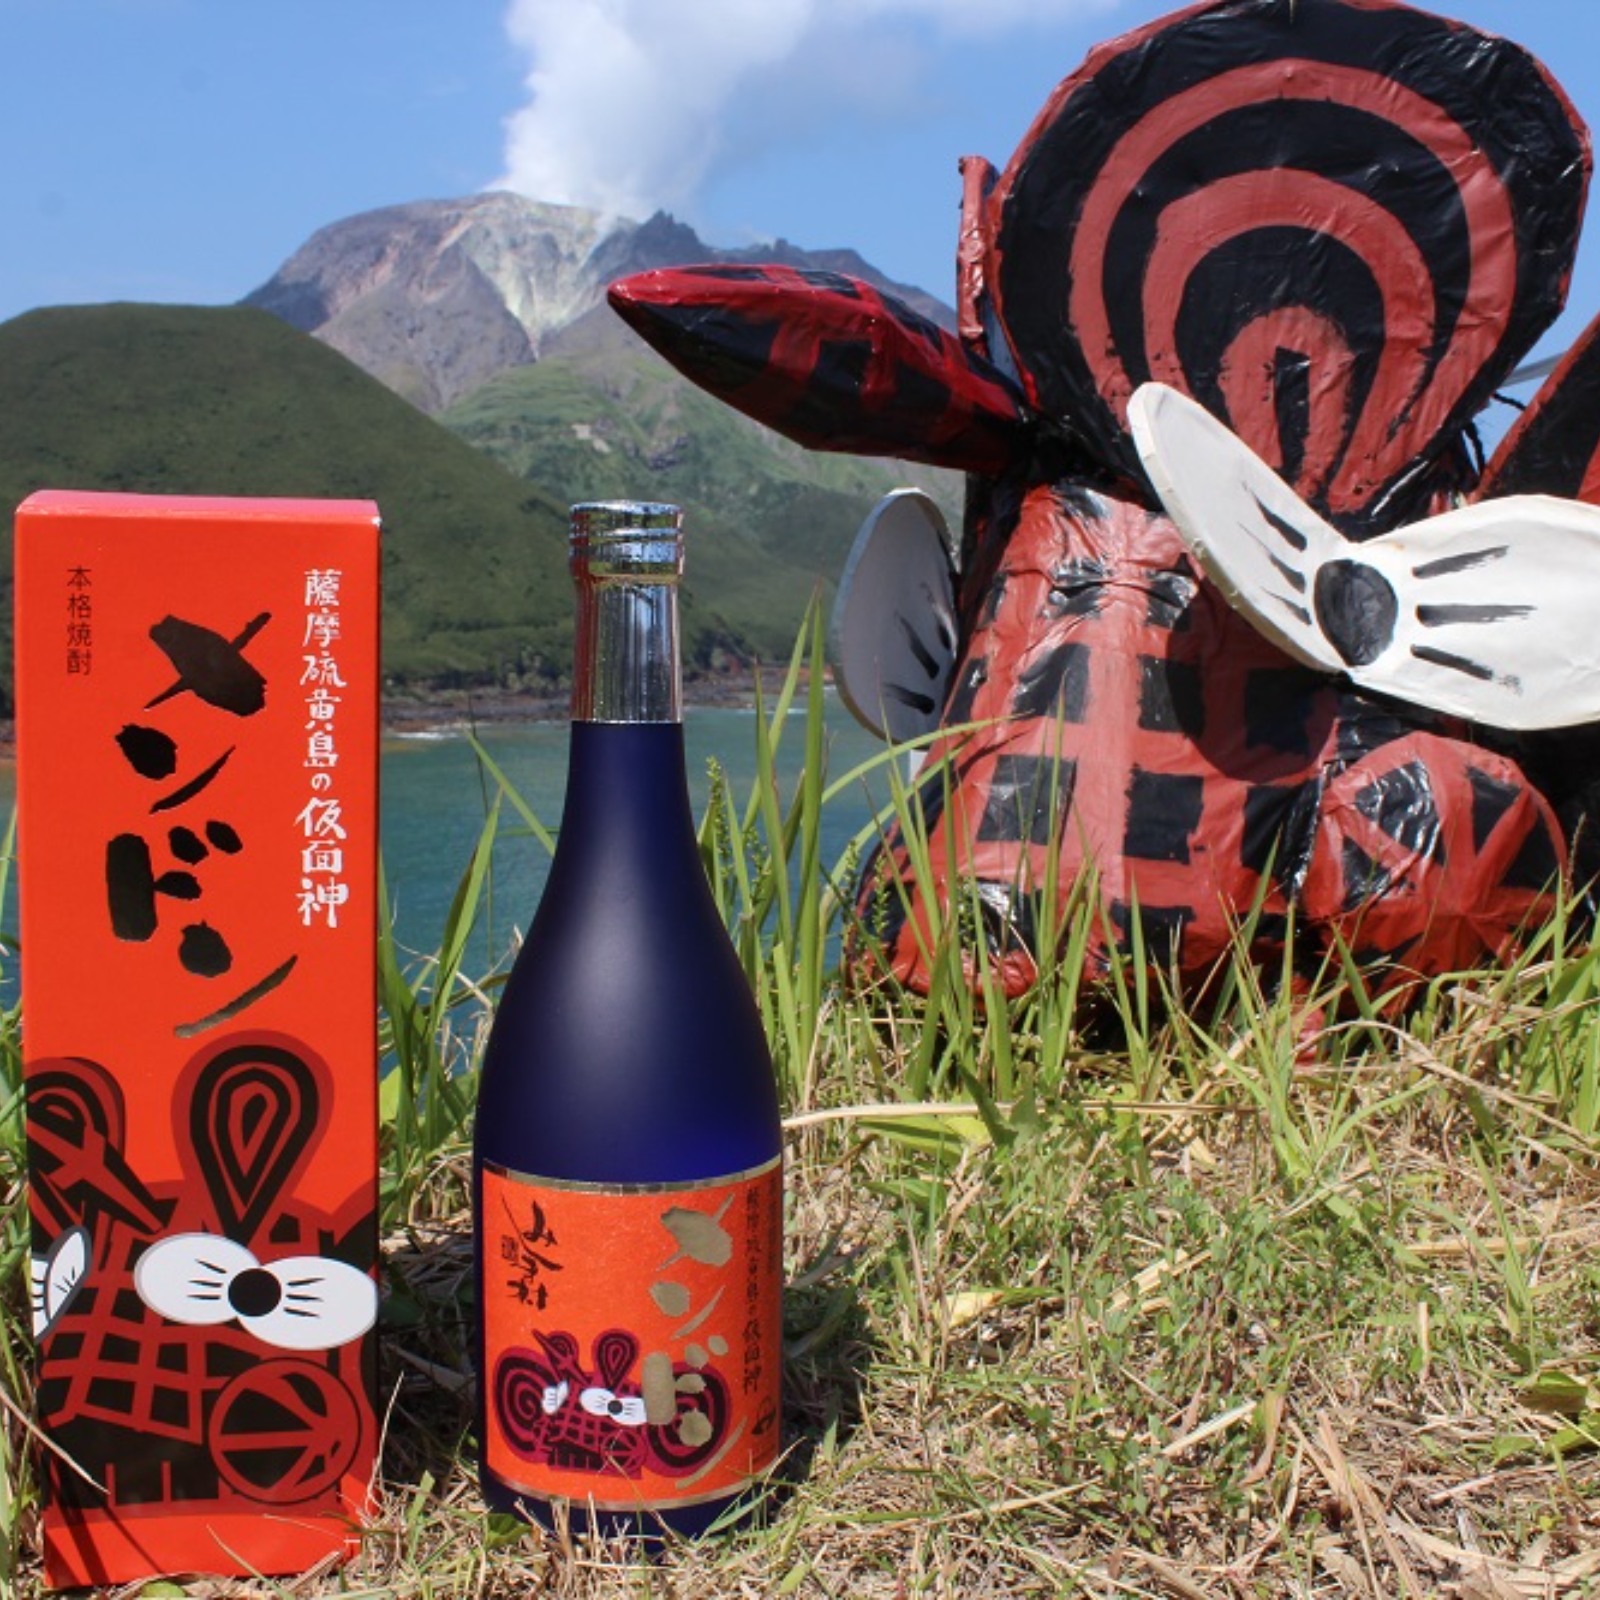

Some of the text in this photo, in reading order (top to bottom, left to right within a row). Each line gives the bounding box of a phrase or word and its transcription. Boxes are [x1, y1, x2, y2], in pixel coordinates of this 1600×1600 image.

[66, 564, 92, 676] 本格焼酎
[295, 568, 348, 928] 薩摩硫黄島の仮面神
[106, 611, 298, 1038] メンドン
[642, 1192, 748, 1490] メンドン
